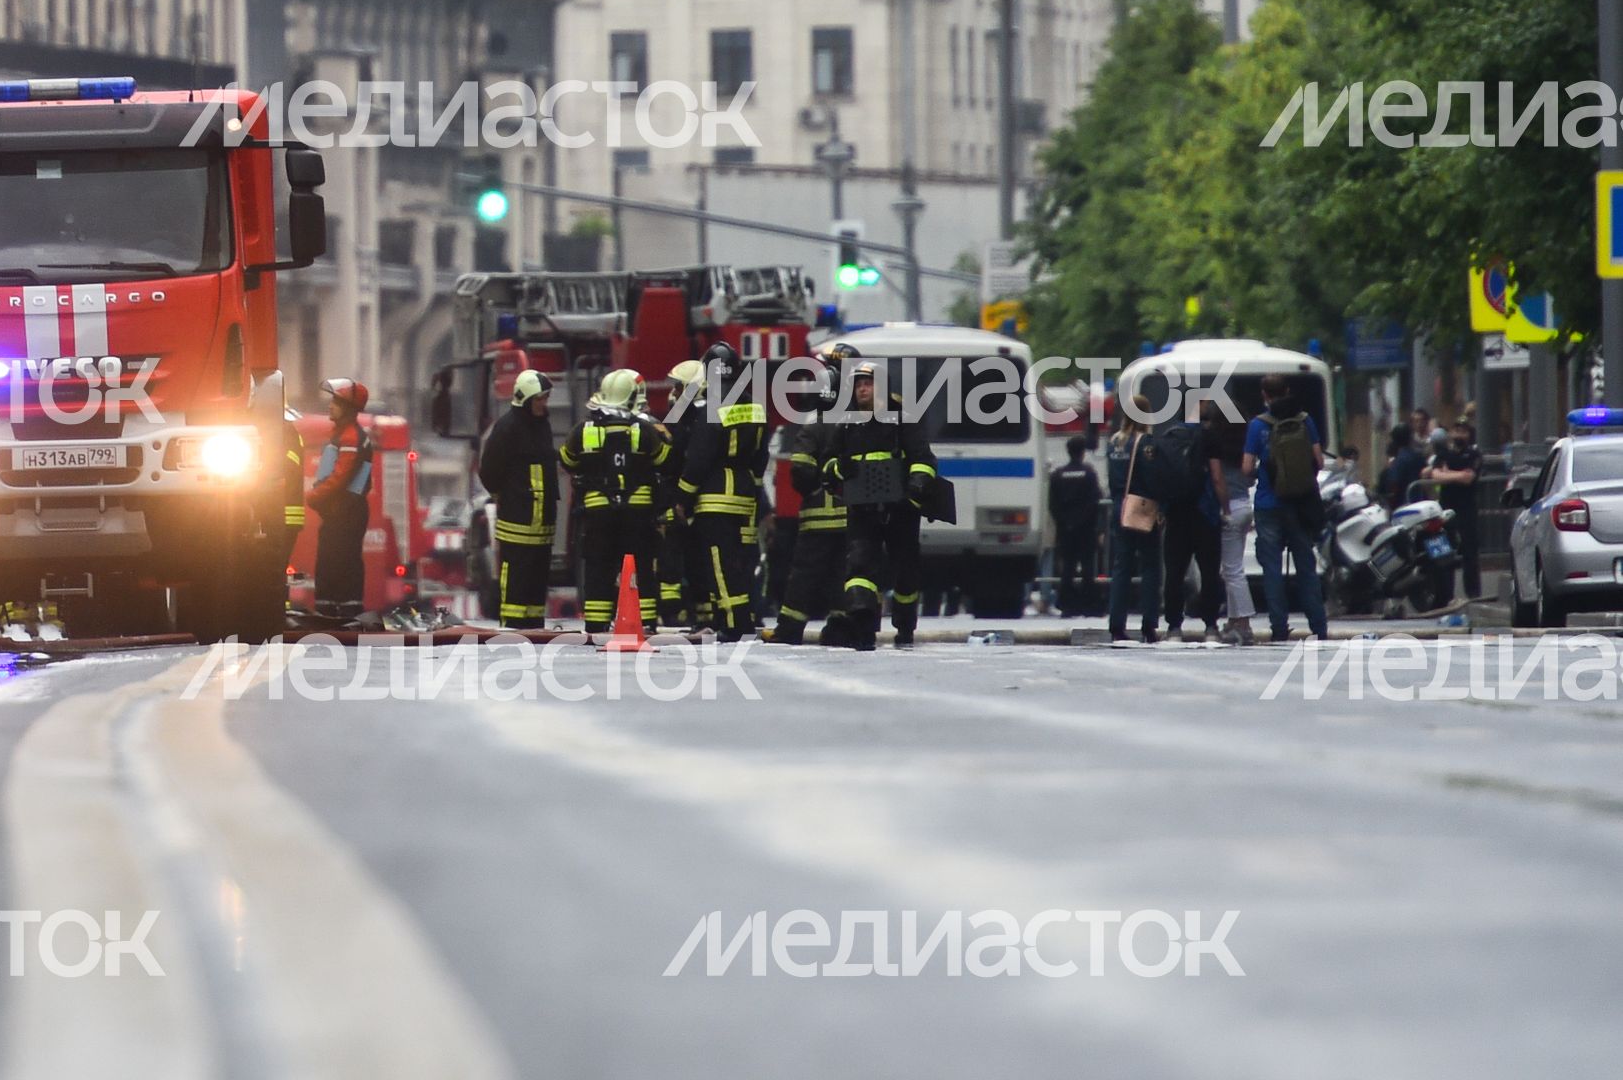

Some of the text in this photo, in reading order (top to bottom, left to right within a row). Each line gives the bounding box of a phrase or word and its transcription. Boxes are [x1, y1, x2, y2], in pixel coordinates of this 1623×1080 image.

[11, 356, 122, 380] IVECO
[28, 448, 112, 467] Н313АВ 799
